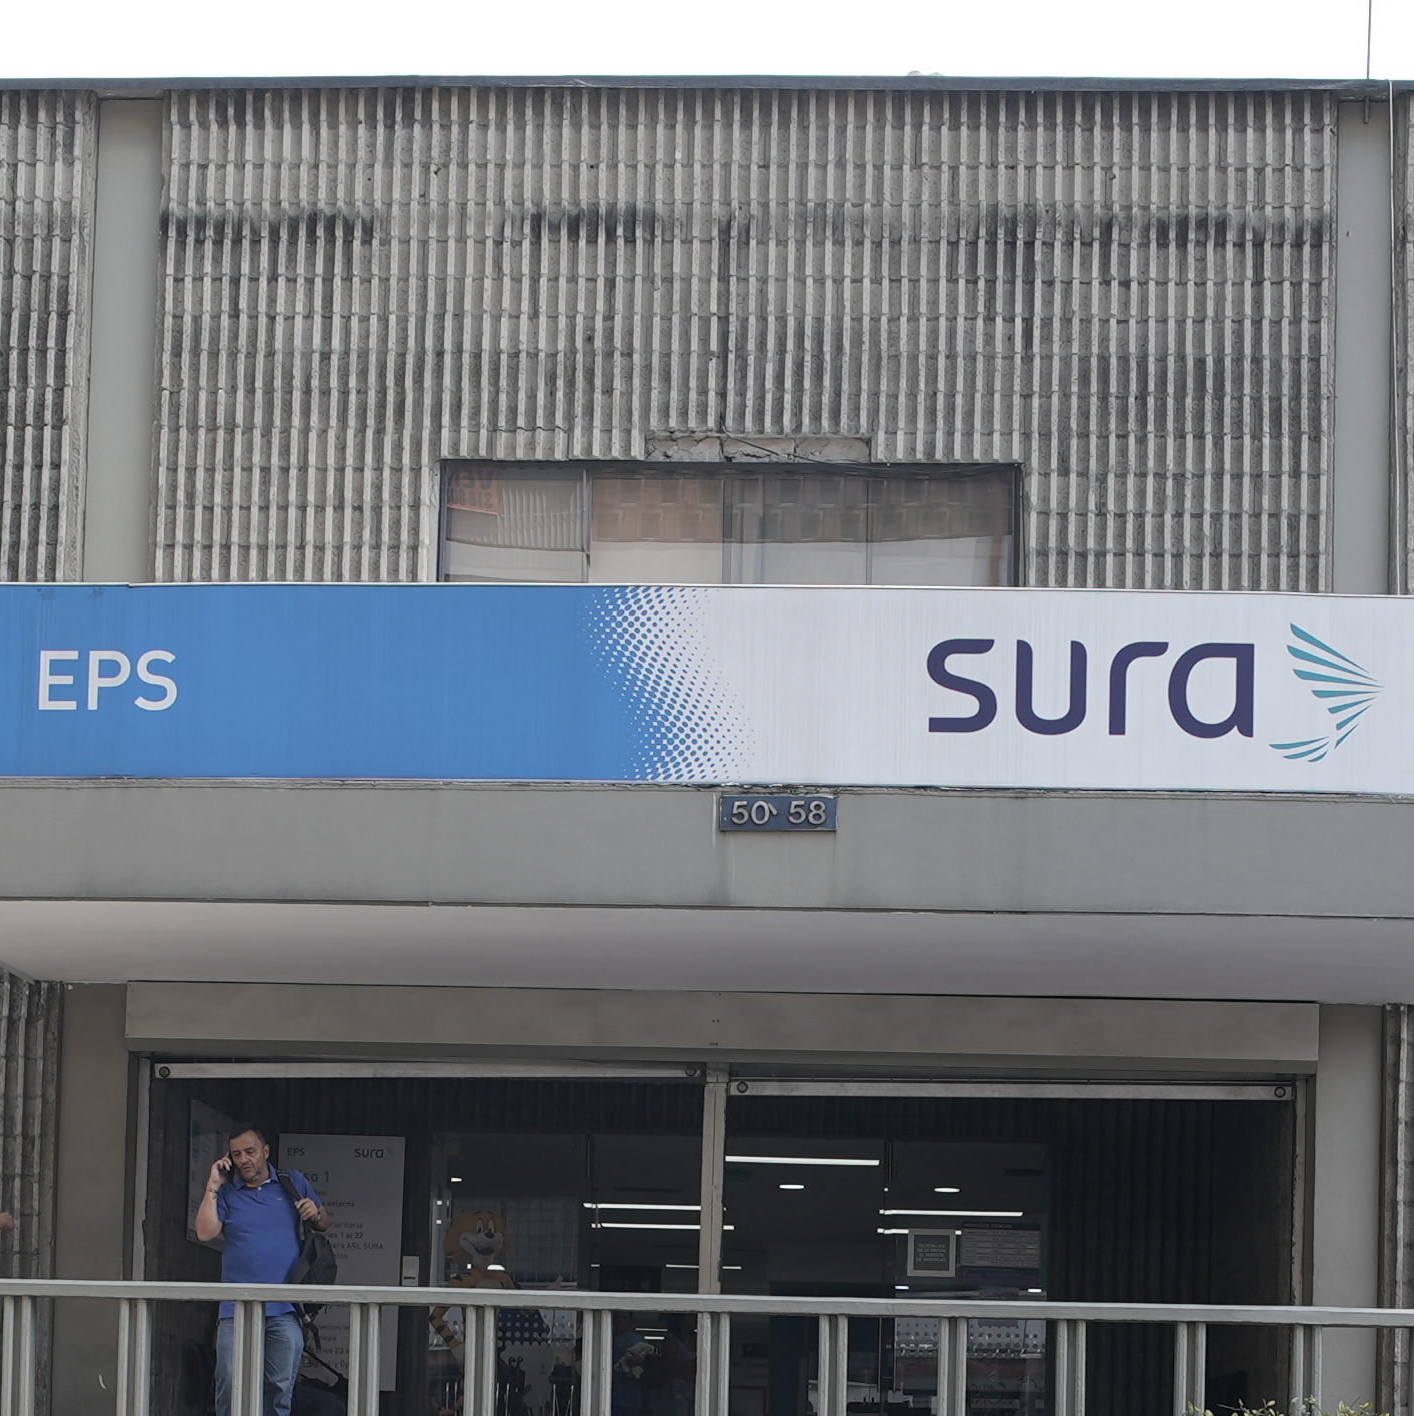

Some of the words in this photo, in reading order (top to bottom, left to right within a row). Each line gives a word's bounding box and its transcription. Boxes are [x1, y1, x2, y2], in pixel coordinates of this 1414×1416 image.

[37, 649, 179, 712] EPS
[926, 637, 1256, 739] sura
[287, 1147, 305, 1156] EPS
[354, 1148, 384, 1158] sura
[323, 1170, 329, 1183] 1
